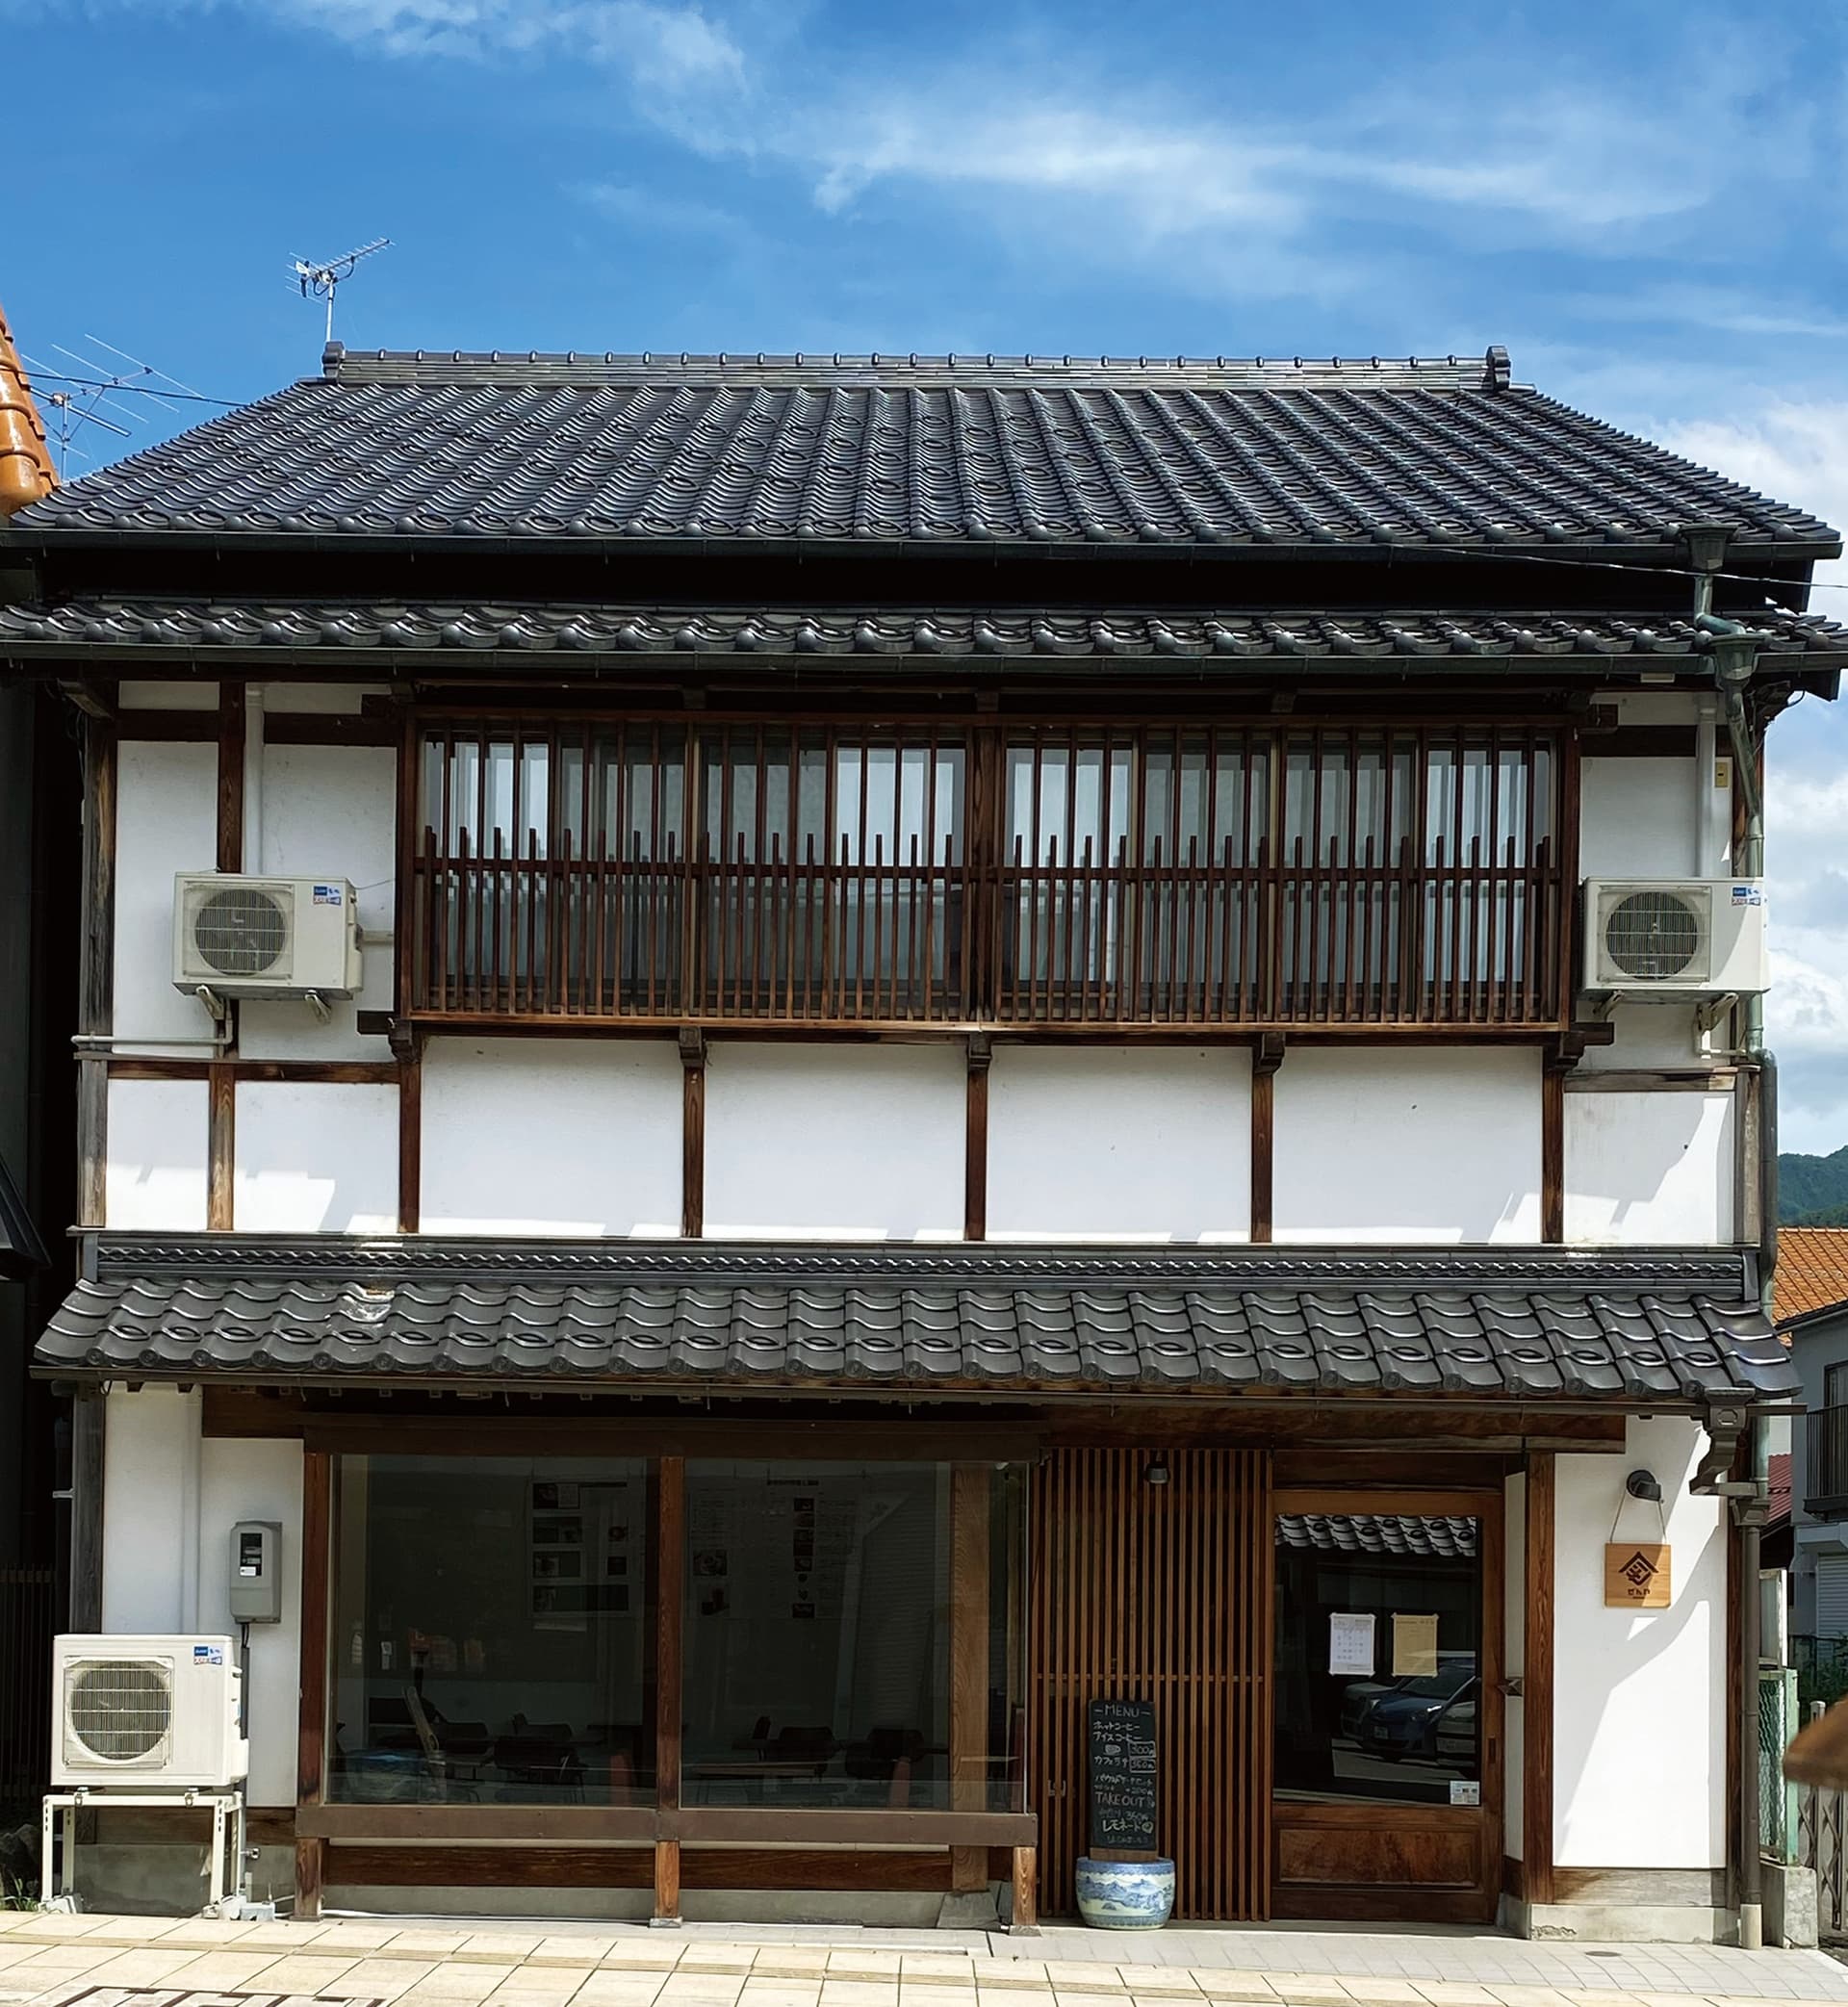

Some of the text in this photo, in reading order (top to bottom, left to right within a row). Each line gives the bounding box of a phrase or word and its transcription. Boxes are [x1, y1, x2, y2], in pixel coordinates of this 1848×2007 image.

[1102, 1817, 1142, 1832] レモネード
